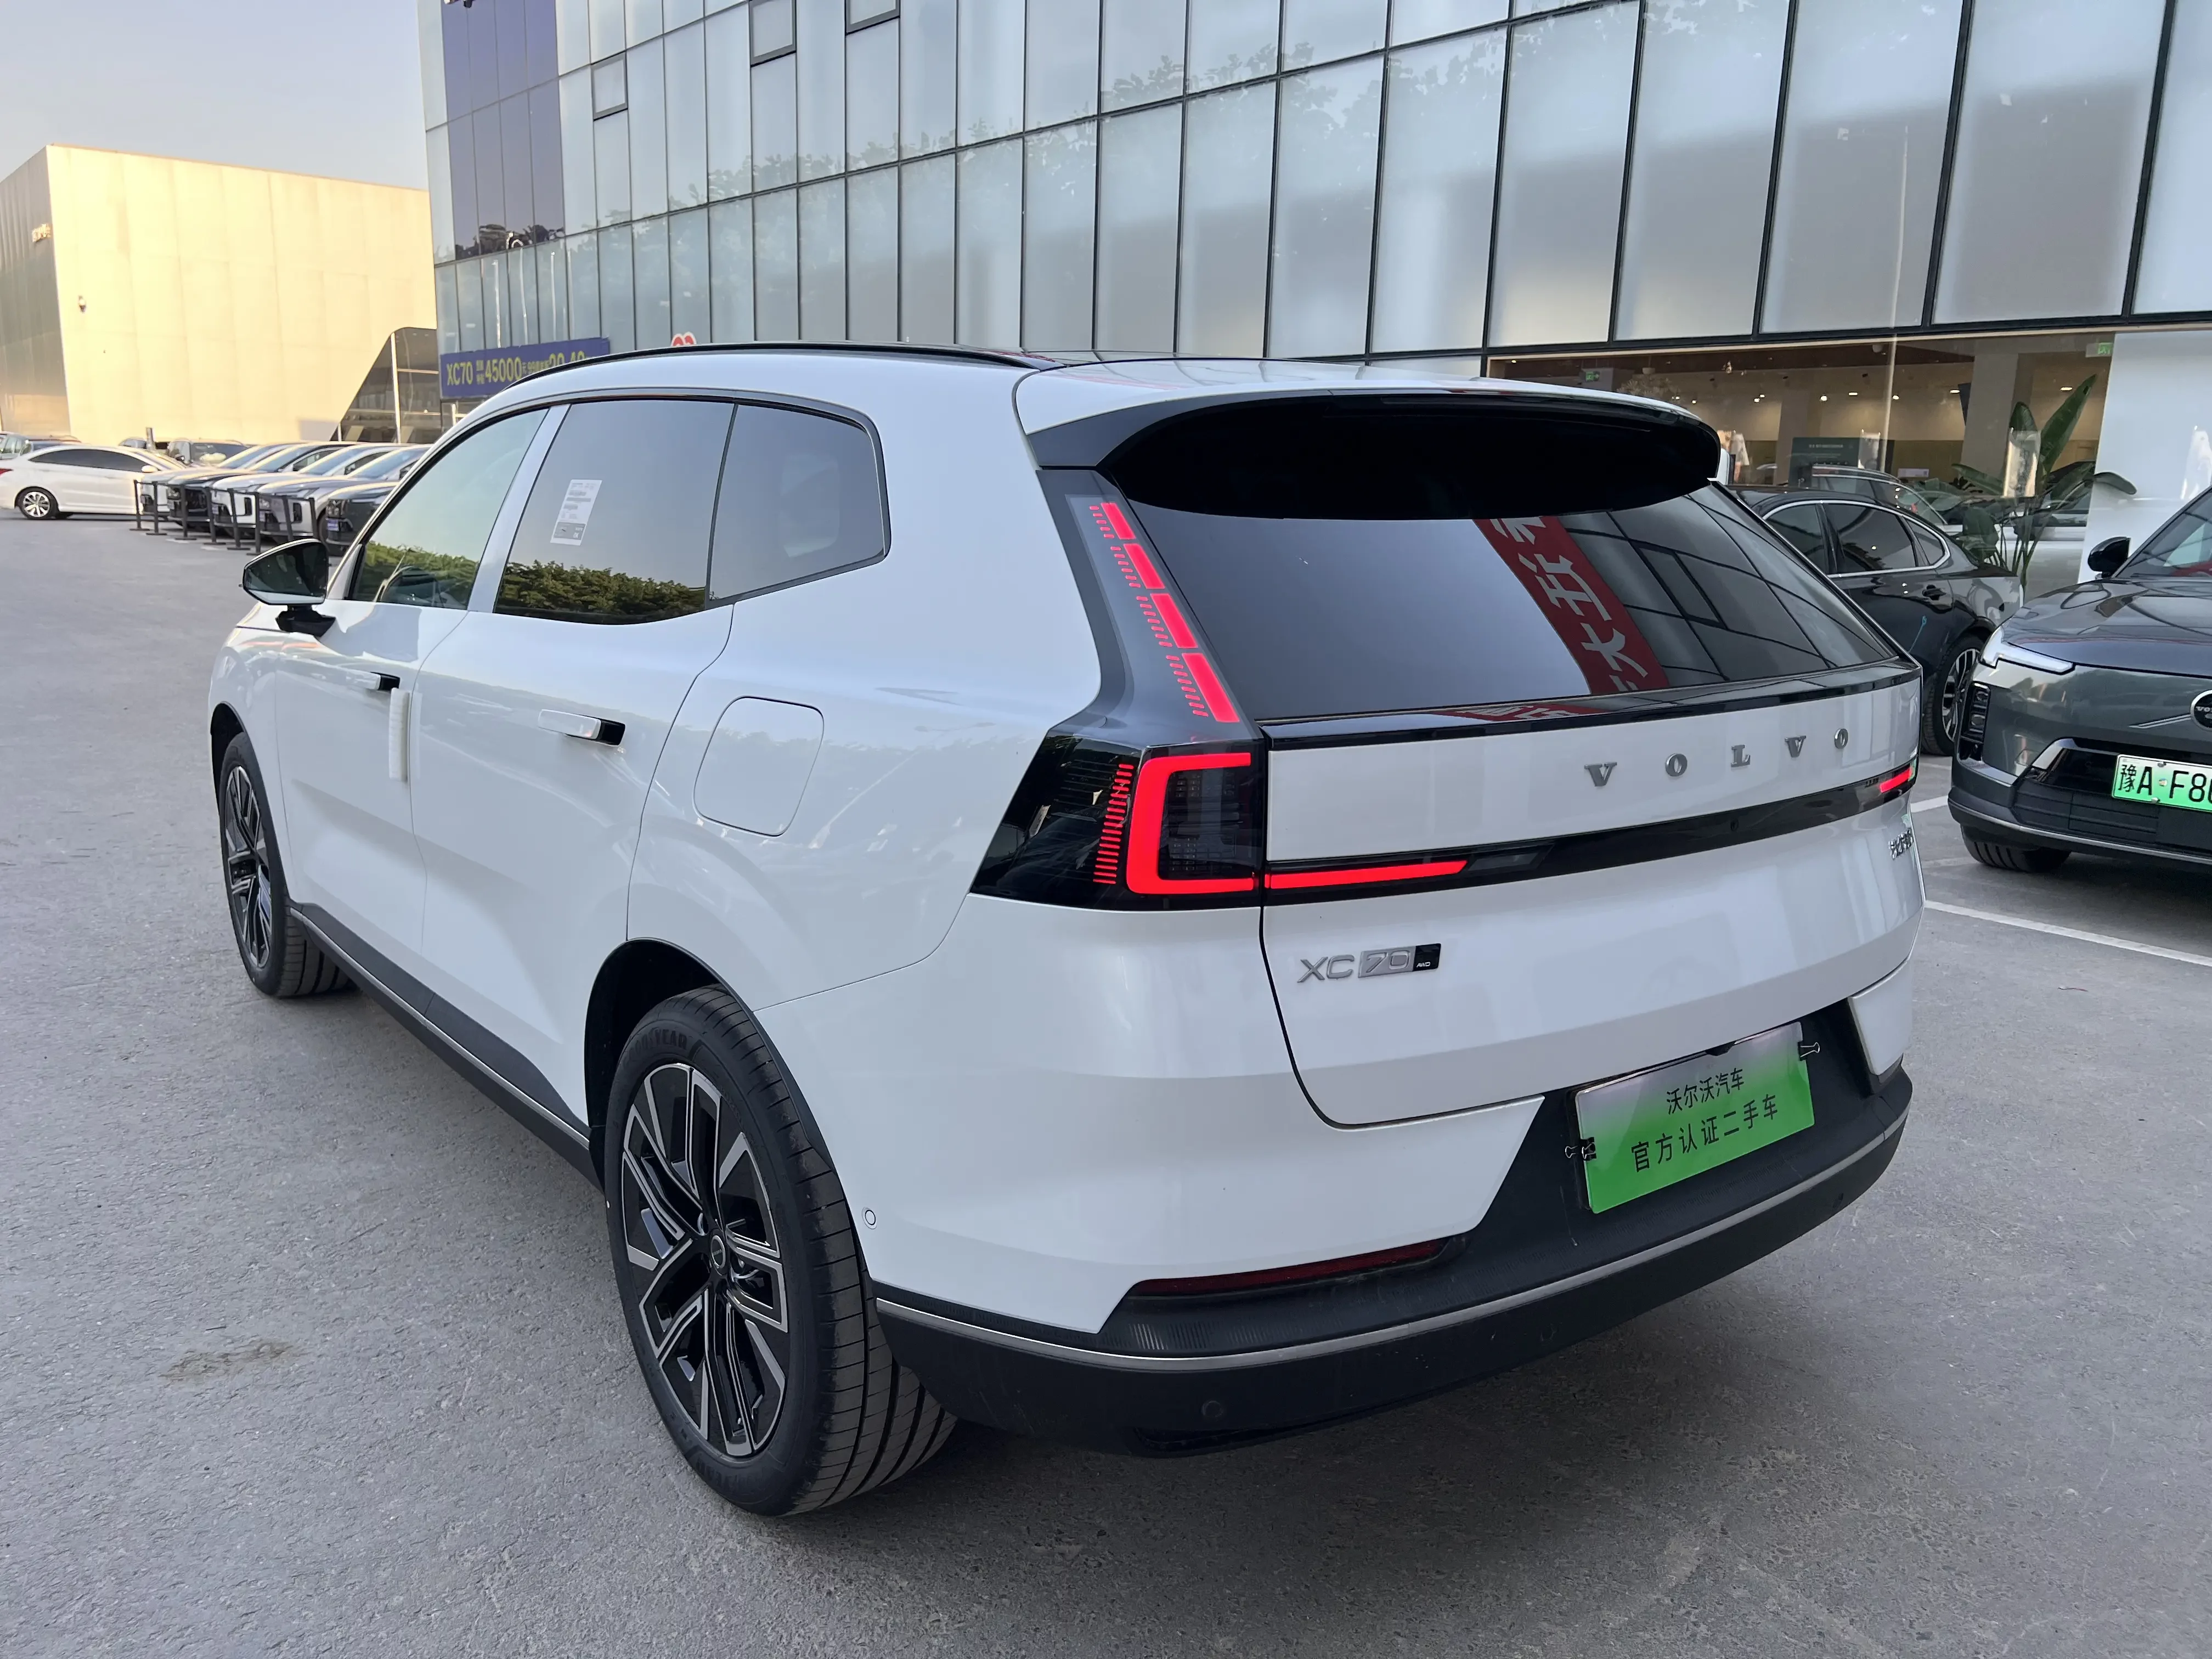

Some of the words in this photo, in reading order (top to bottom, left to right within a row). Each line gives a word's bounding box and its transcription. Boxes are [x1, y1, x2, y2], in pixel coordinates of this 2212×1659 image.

[447, 362, 473, 386] XC70
[1584, 728, 1849, 787] VOLVO
[1666, 1067, 1745, 1115] 沃尔沃汽车
[1631, 1093, 1778, 1172] 官方认证二手车
